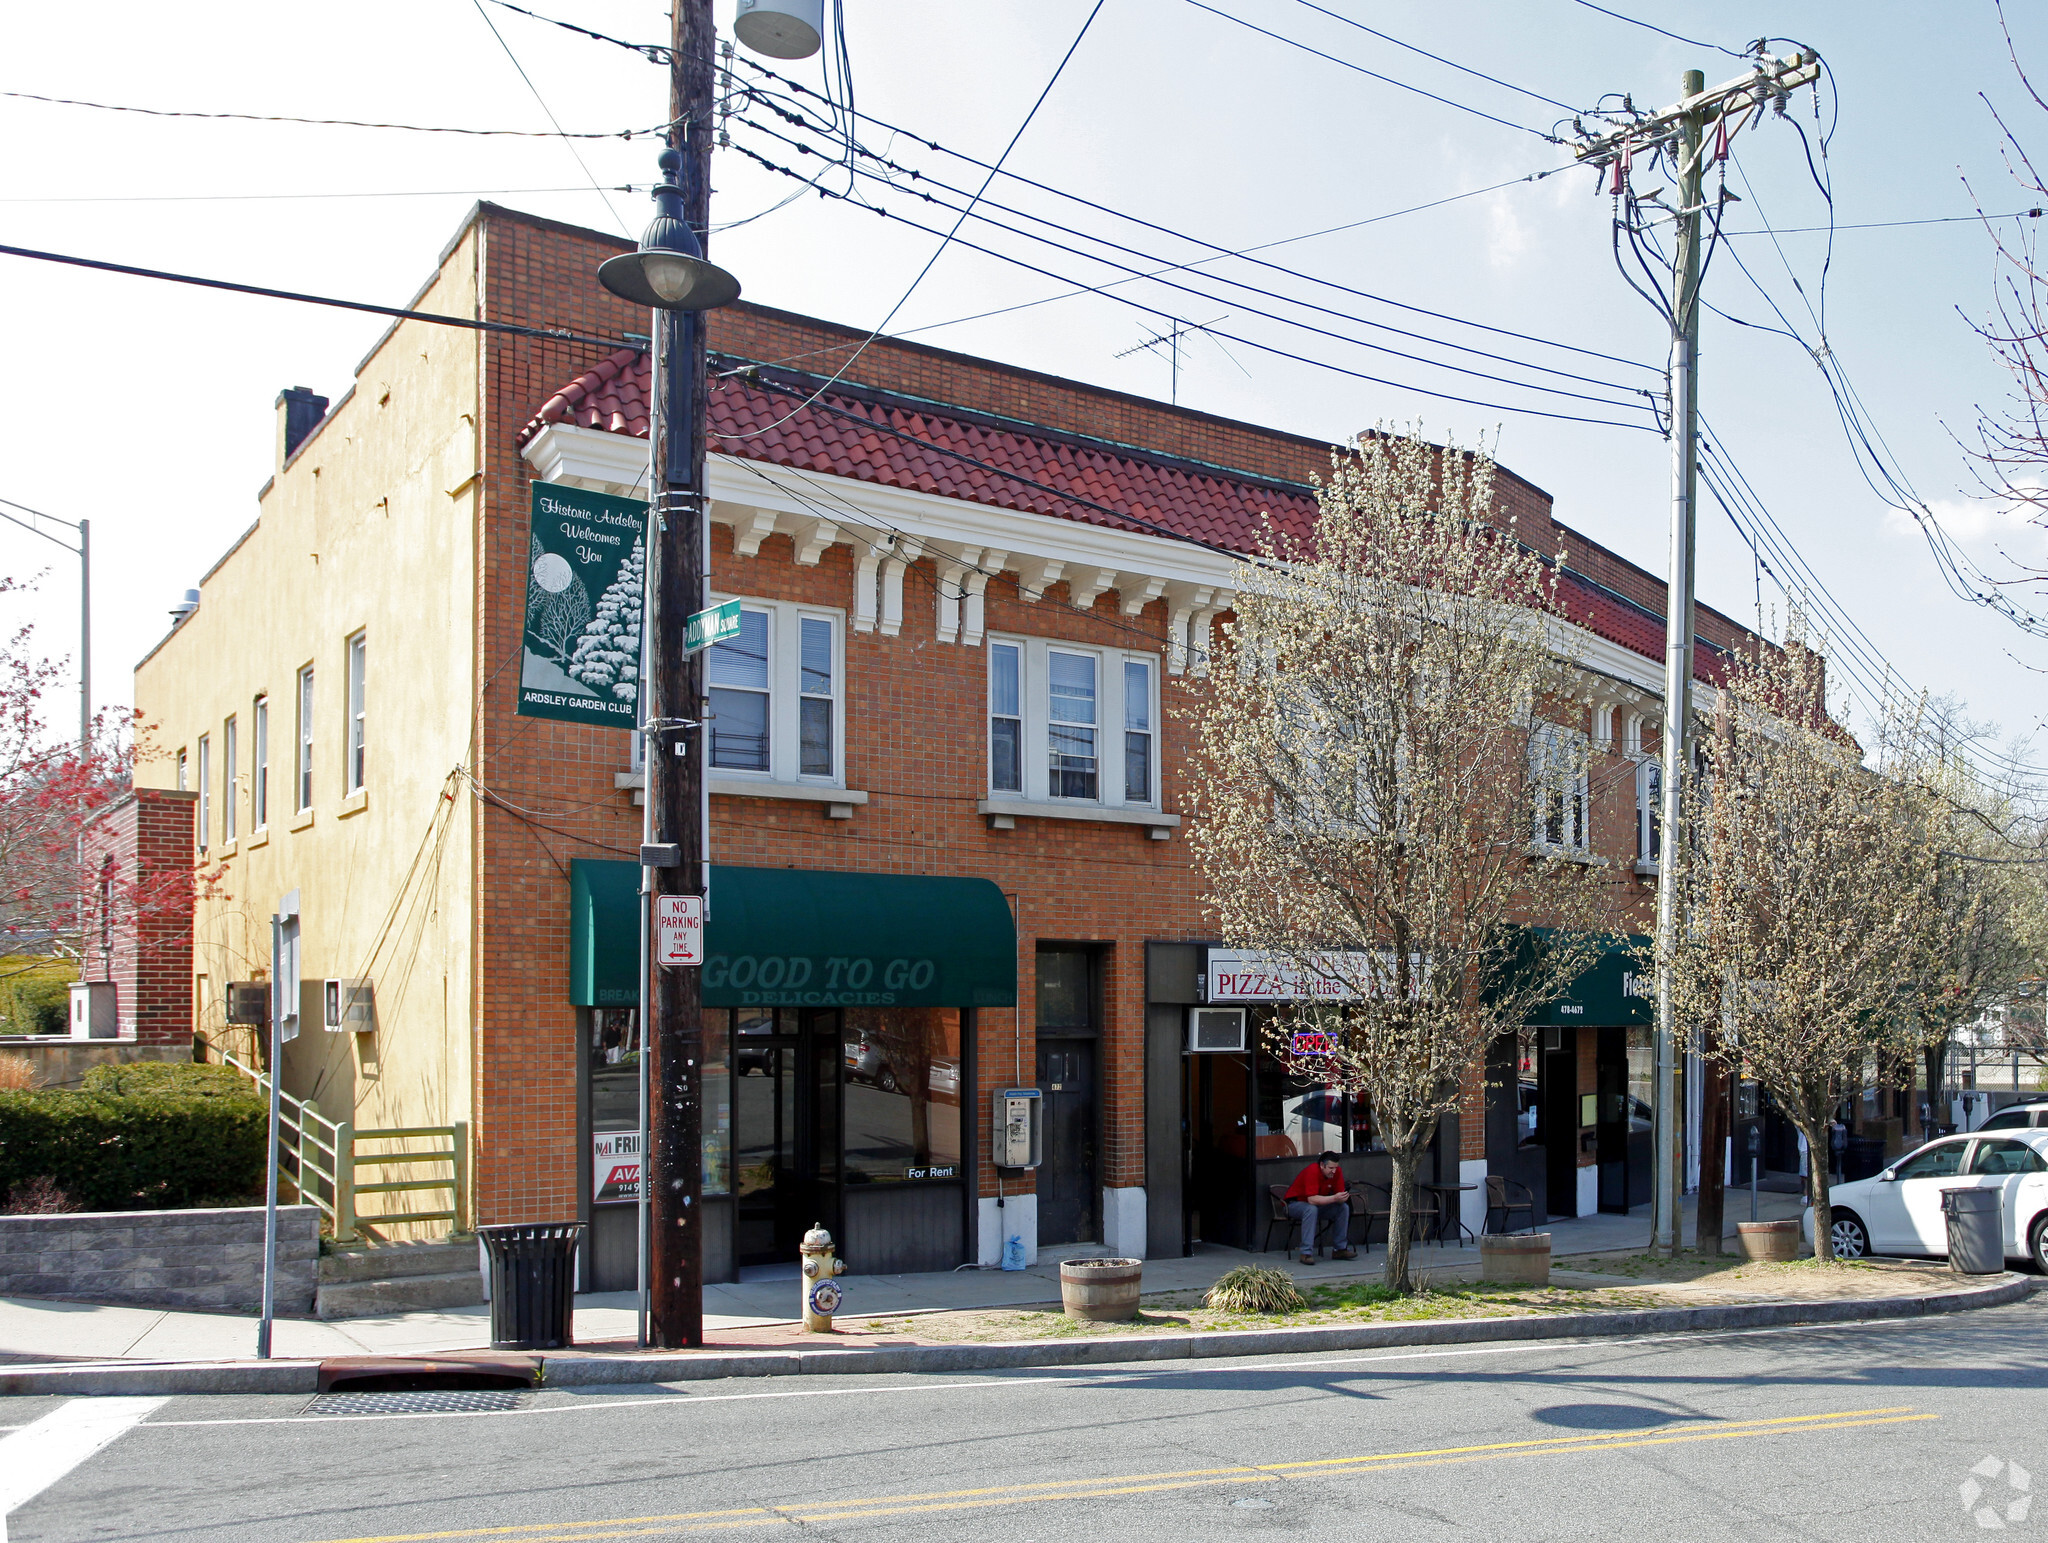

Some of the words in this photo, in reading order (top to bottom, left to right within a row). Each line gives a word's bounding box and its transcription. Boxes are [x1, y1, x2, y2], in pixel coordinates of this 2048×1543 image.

[540, 497, 592, 520] Historic
[594, 509, 643, 533] Ardsley
[560, 522, 621, 546] Welcomes
[575, 545, 603, 564] You
[687, 612, 720, 643] ADDYMAN
[524, 692, 567, 706] ARDSLEY
[568, 697, 606, 712] GARDEN
[608, 702, 632, 714] CLUB
[672, 901, 688, 913] NO
[661, 916, 699, 929] PARKING
[673, 932, 688, 941] ANY
[673, 943, 688, 952] TIME
[701, 955, 813, 989] GOOD
[825, 957, 874, 989] TO
[883, 959, 935, 990] GO
[1217, 973, 1285, 995] PIZZA
[1316, 976, 1341, 995] the
[741, 991, 896, 1005] DELICACIES
[908, 1168, 926, 1179] For
[929, 1166, 953, 1177] Rent
[618, 1184, 633, 1192] 914
